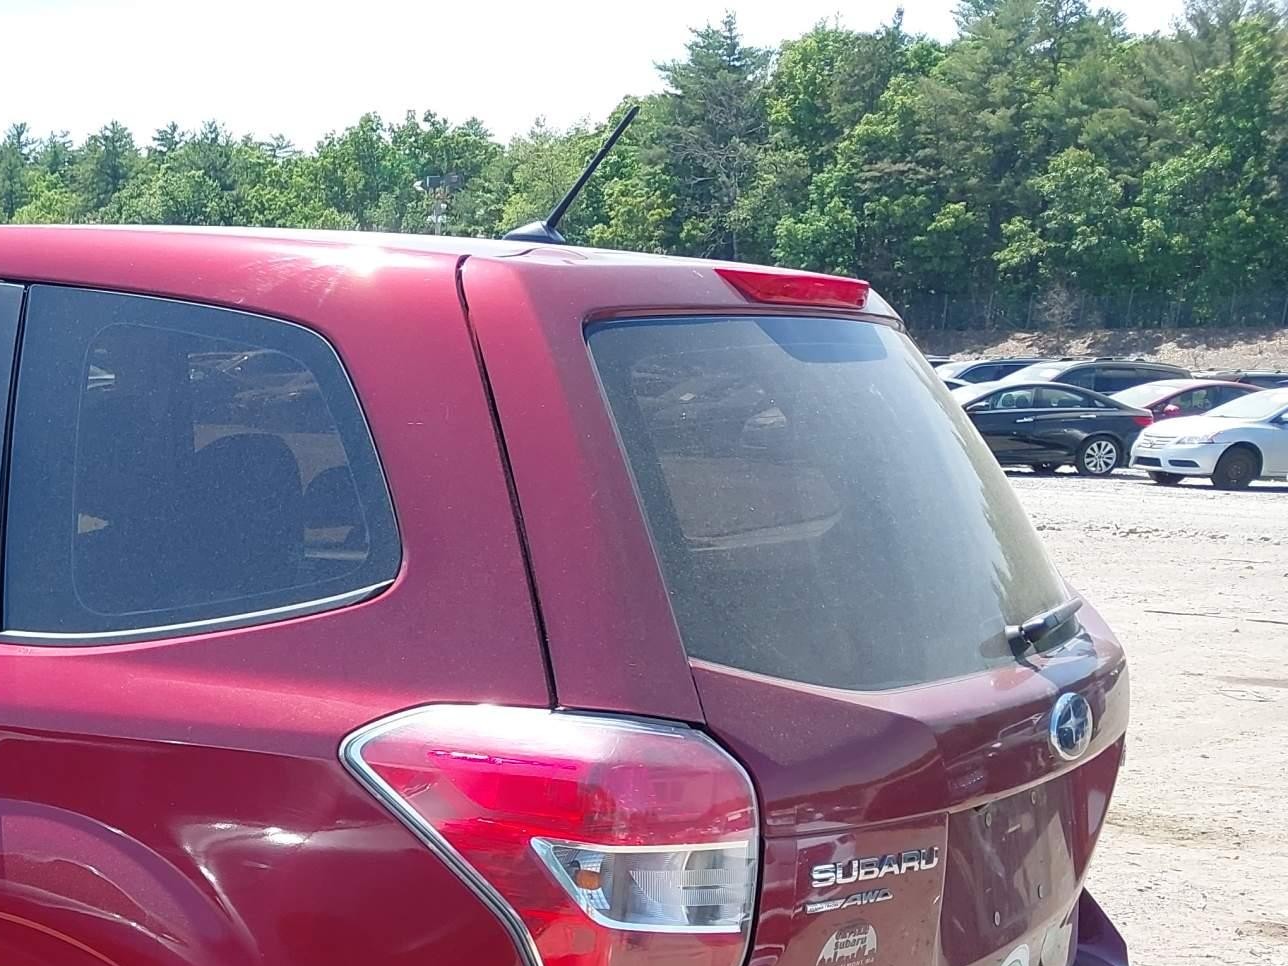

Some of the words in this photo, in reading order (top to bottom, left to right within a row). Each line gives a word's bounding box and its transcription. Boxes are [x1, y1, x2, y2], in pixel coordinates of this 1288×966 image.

[811, 847, 939, 888] SUBARU
[841, 888, 893, 909] AWD
[833, 936, 867, 951] Subaru
